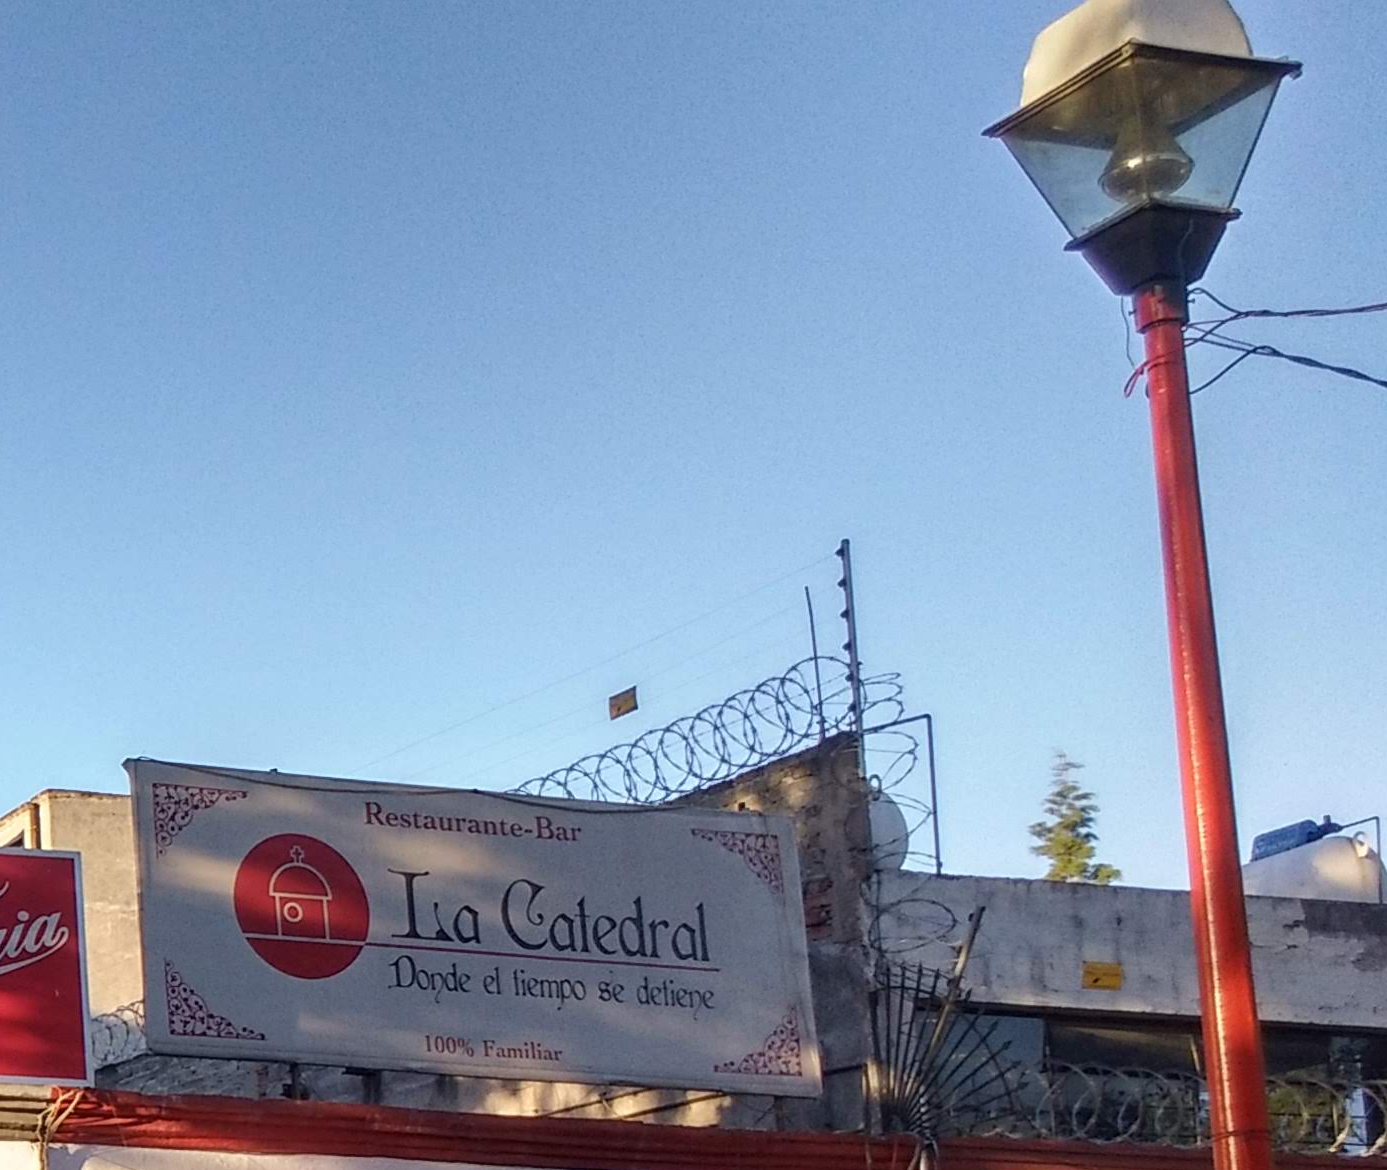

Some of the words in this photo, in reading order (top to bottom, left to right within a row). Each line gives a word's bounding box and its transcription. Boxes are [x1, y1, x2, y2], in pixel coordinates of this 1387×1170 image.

[364, 802, 582, 844] Restaurante-Bar
[387, 868, 480, 944] La
[502, 879, 711, 963] Catedral
[387, 954, 471, 1004] Donde
[483, 967, 500, 995] el
[513, 963, 586, 1011] tiempo
[598, 970, 626, 1003] se
[637, 976, 714, 1022] detiene
[425, 1035, 474, 1058] 100%
[483, 1039, 563, 1063] Familiar
